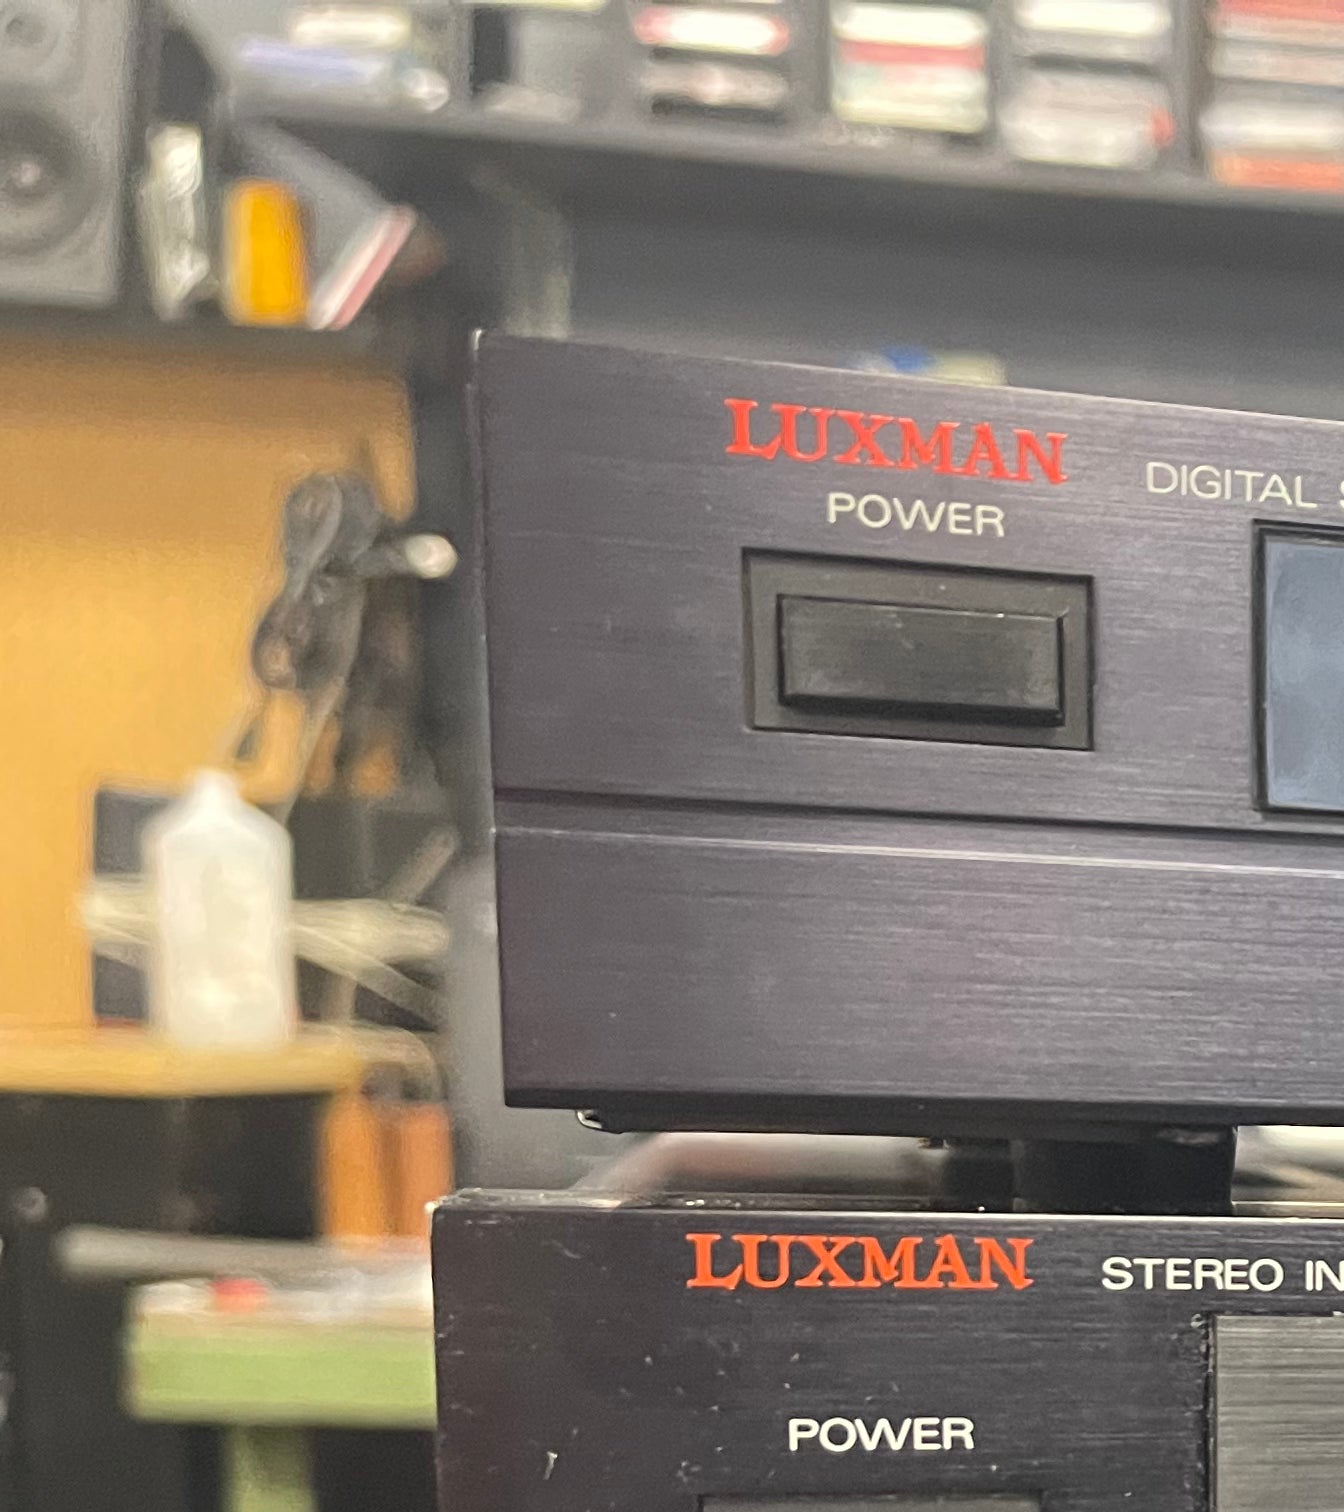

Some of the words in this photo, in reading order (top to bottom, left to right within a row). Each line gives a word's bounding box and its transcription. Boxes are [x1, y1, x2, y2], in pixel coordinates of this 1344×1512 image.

[724, 398, 1067, 484] LUXMAN
[1145, 462, 1318, 508] DIGITAL
[826, 491, 1006, 537] POWER
[686, 1232, 1034, 1292] LUXMAN
[1101, 1257, 1283, 1293] STEREO
[788, 1416, 976, 1453] POWER
